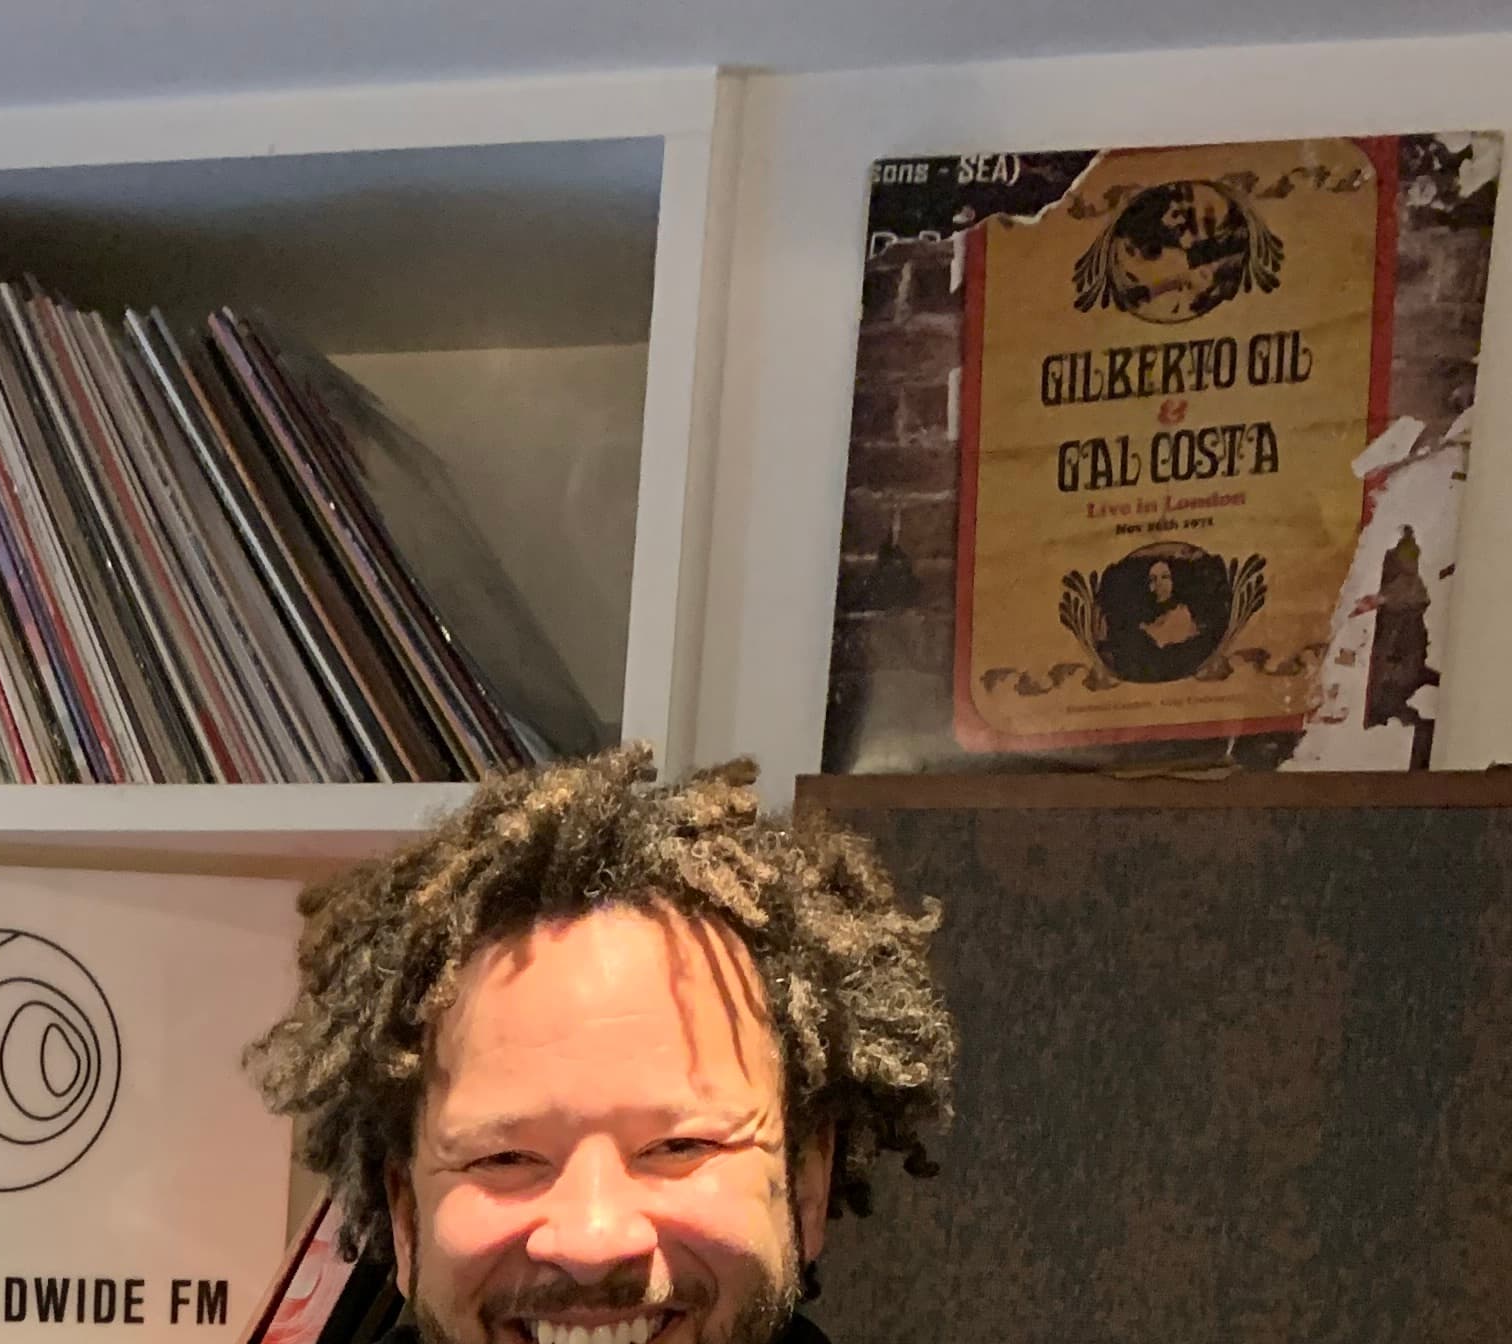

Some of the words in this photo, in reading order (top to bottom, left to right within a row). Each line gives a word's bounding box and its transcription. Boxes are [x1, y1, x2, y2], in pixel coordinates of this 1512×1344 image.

[1041, 336, 1238, 407] GILBERTO
[1247, 329, 1313, 386] GIL
[1058, 435, 1141, 492] GAL
[1150, 421, 1279, 484] COSTA
[170, 1279, 229, 1326] FM
